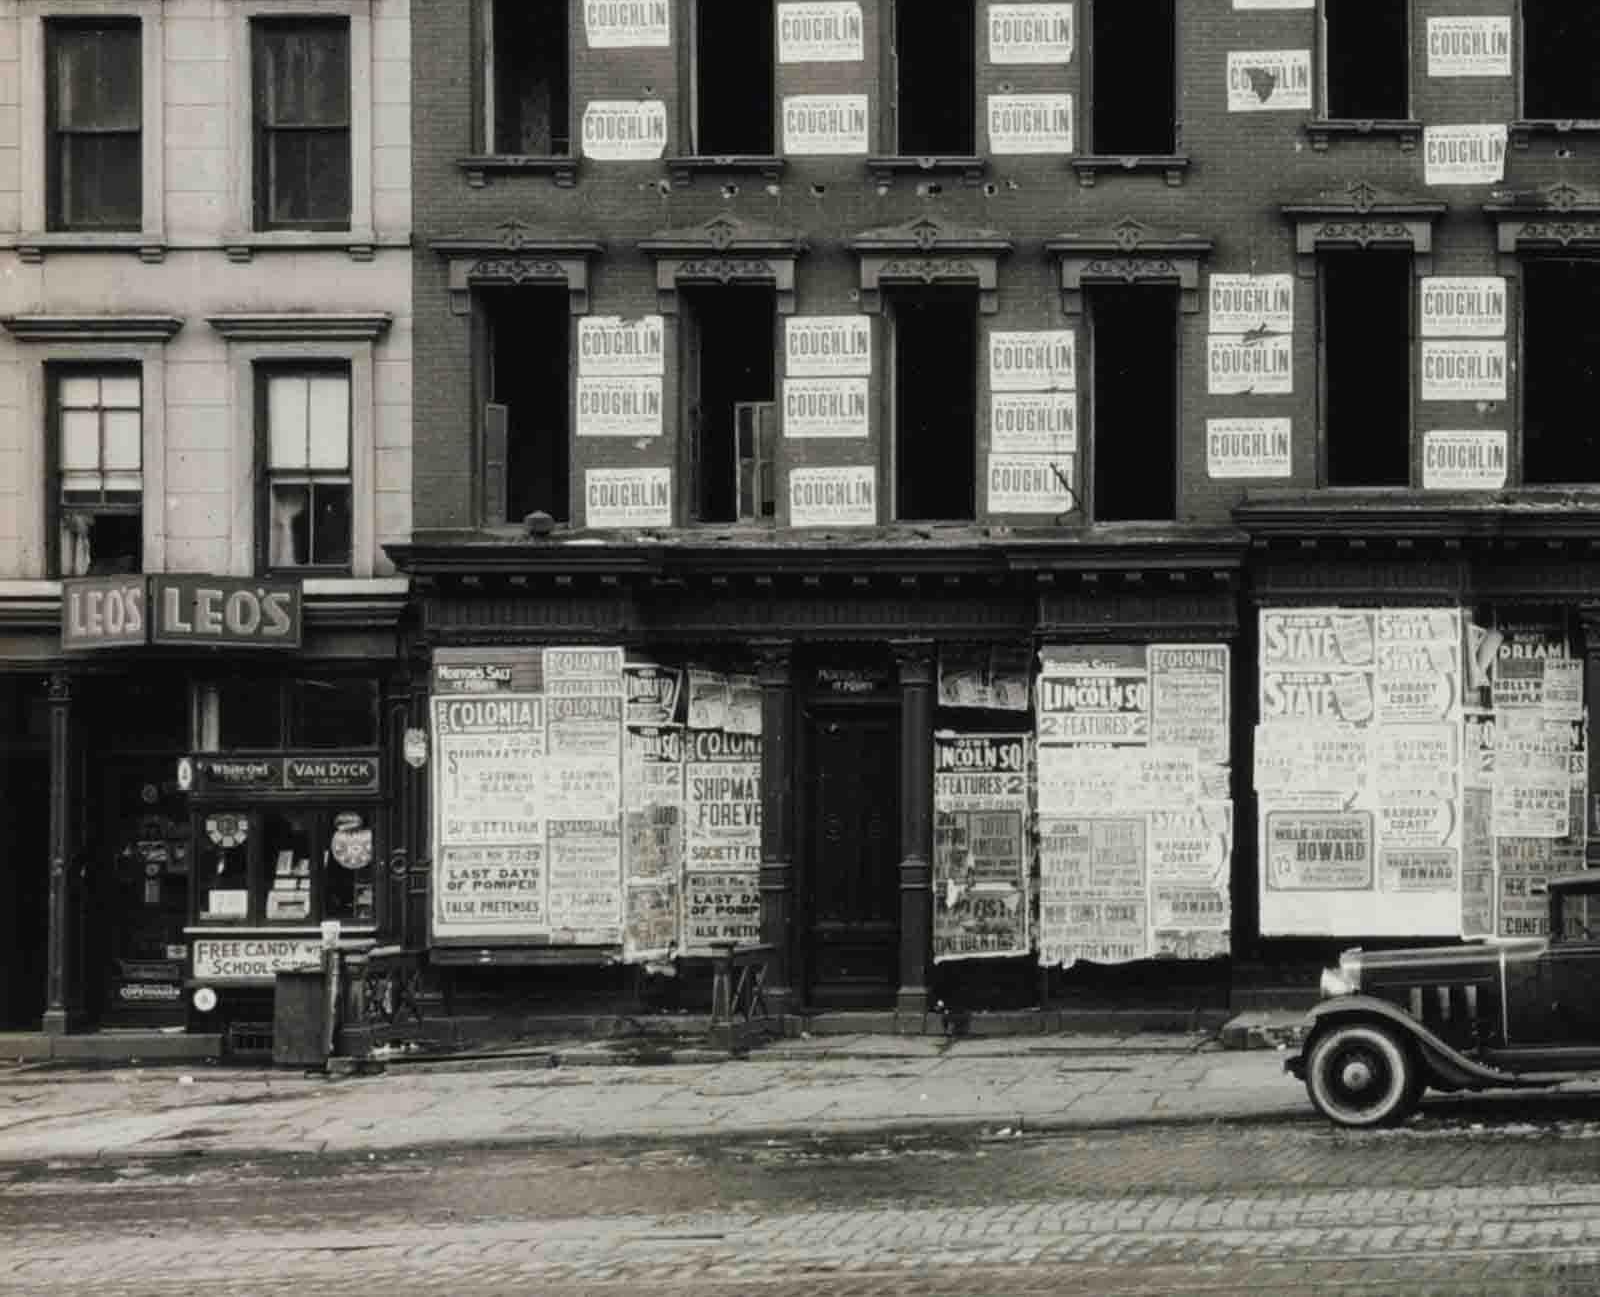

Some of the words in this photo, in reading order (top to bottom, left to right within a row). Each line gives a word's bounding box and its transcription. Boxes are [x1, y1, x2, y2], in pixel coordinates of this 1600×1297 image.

[588, 2, 668, 26] COUGHLIN
[781, 17, 861, 41] COUGHLIN
[1431, 31, 1508, 54] COUGHLIN
[786, 109, 866, 133] COUGHLIN
[1427, 139, 1507, 163] COUGHLIN
[789, 331, 869, 355] COUGHLIN
[1211, 349, 1291, 373] COUGHLIN
[1425, 355, 1505, 379] COUGHLIN
[580, 391, 660, 415] COUGHLIN
[787, 393, 867, 417] COUGHLIN
[1211, 433, 1288, 456] COUGHLIN
[1426, 444, 1506, 468] COUGHLIN
[589, 482, 669, 506] COUGHLIN
[793, 481, 873, 505] COUGHLIN
[71, 586, 141, 637] LEO'S
[164, 586, 291, 636] LEO'S
[1266, 615, 1336, 662] STATE
[1045, 682, 1122, 710] LINCOLN
[1265, 672, 1336, 719] STATE
[451, 702, 543, 733] COLONIAL
[1042, 717, 1057, 734] 2
[1064, 716, 1127, 734] FEATURES
[294, 764, 326, 776] VAN
[330, 762, 369, 776] DYCK
[1008, 776, 1025, 794] 2
[1296, 842, 1366, 861] HOWARD
[450, 869, 491, 879] LAST
[500, 869, 540, 879] DAYS
[1401, 868, 1453, 879] HOWARD
[447, 881, 465, 891] OF
[694, 894, 732, 904] LAST
[198, 942, 241, 963] FREE
[244, 942, 302, 956] CANDY
[212, 959, 270, 975] SCHOOL
